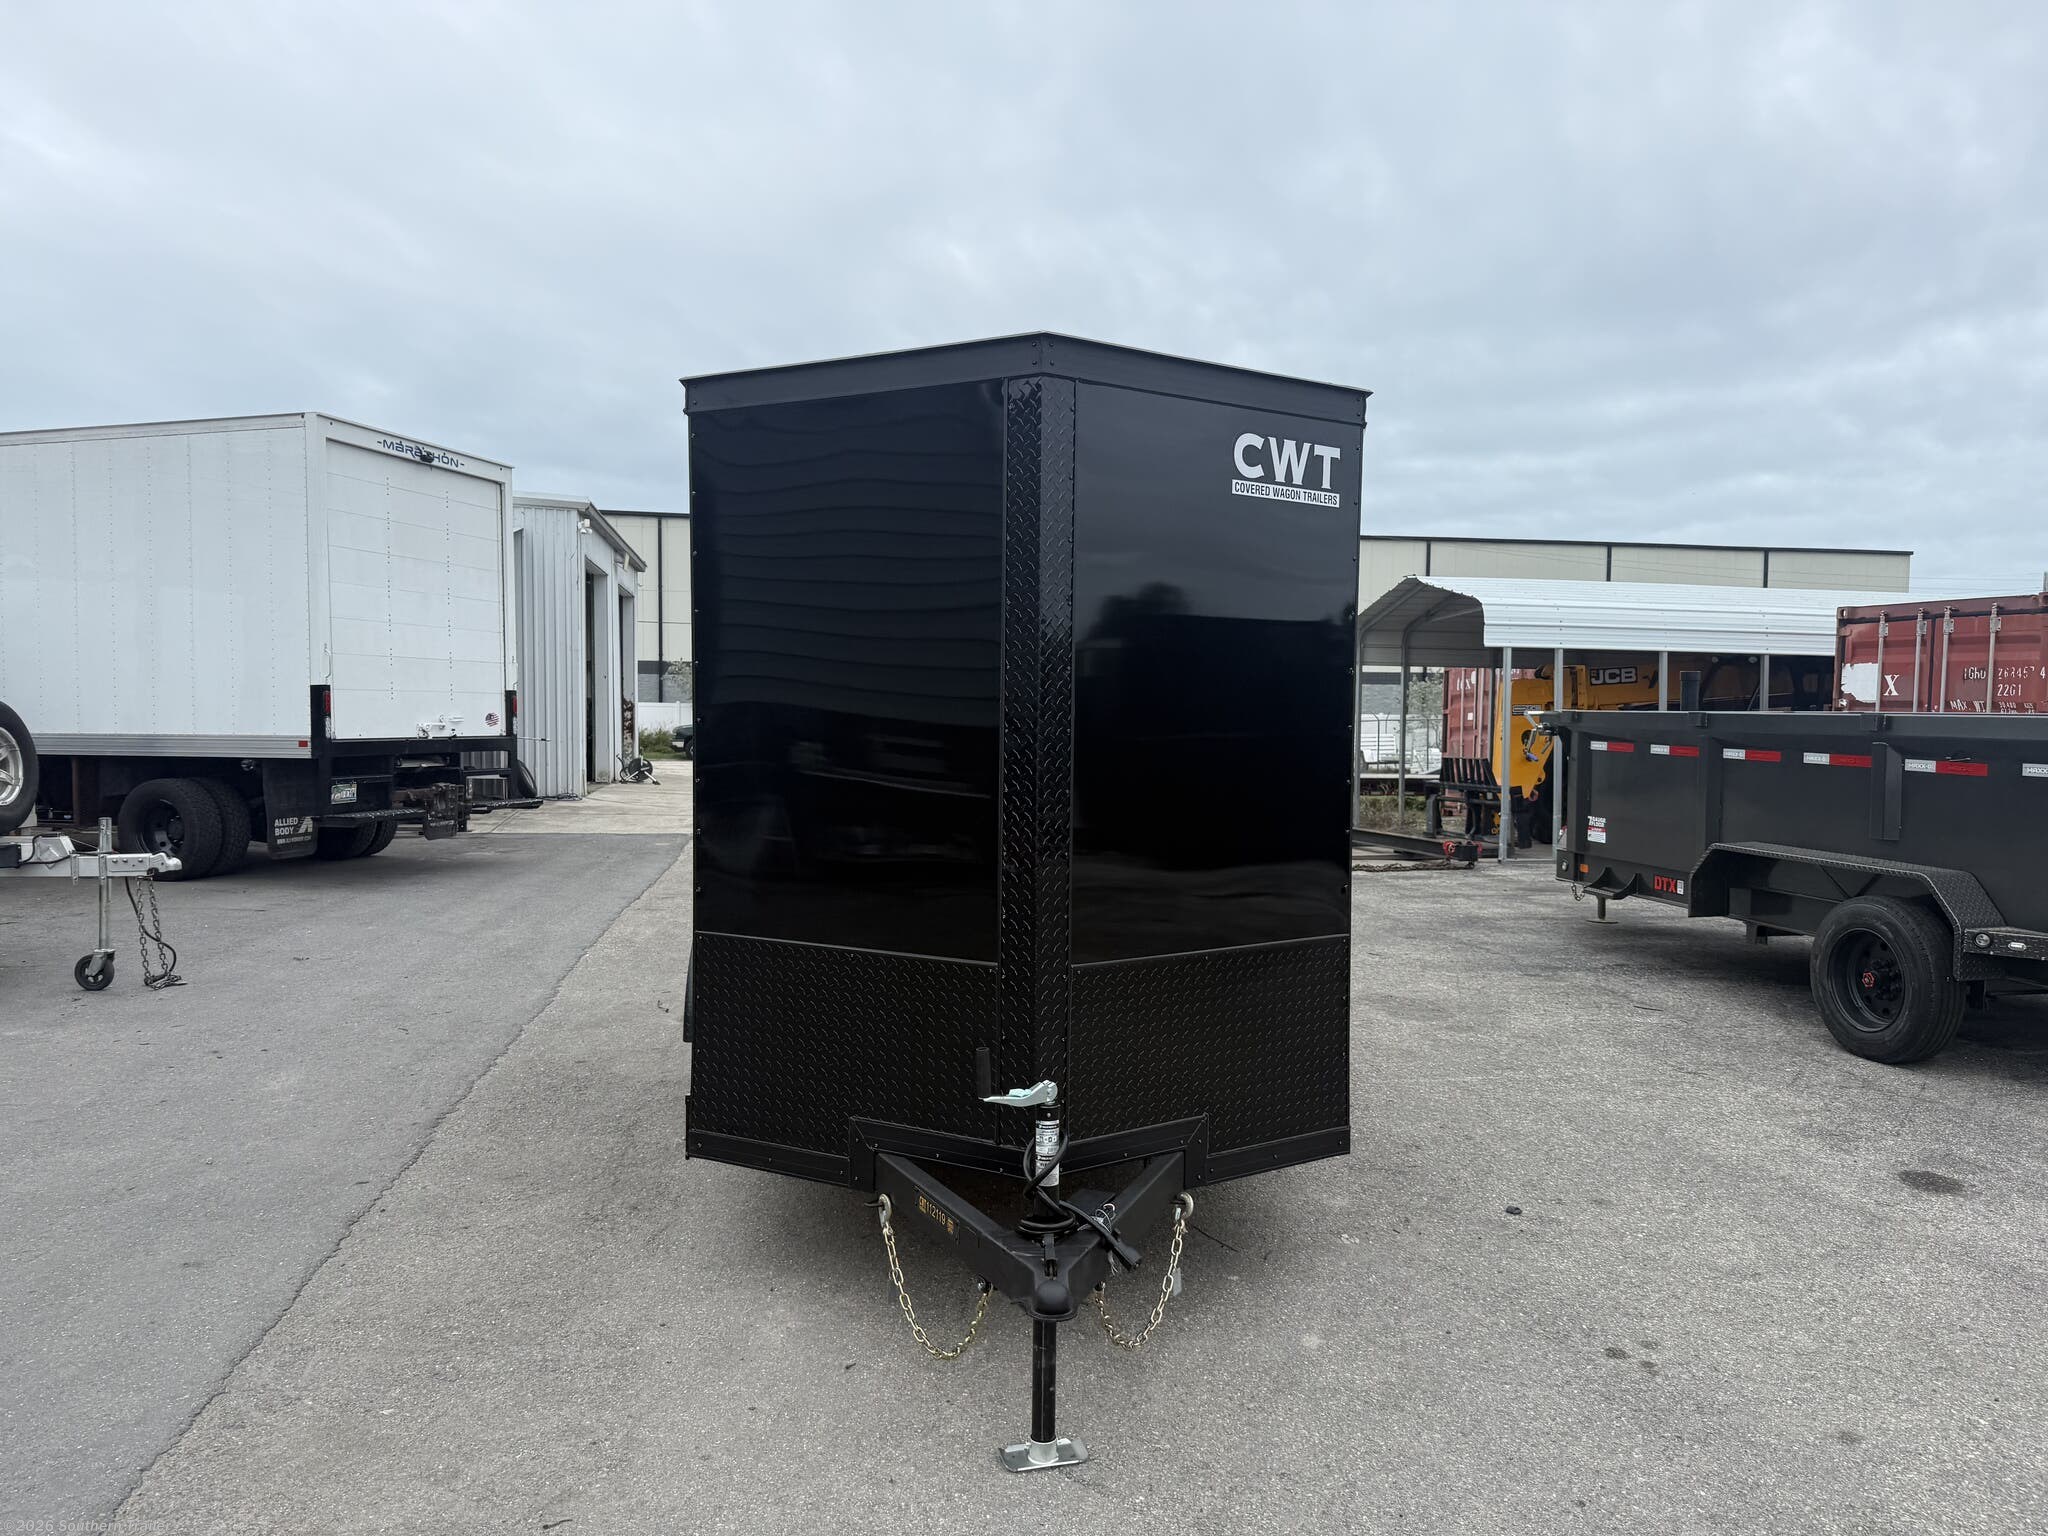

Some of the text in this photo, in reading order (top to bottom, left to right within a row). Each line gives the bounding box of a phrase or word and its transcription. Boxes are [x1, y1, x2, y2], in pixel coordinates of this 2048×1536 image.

[1234, 433, 1340, 489] CWT
[1234, 482, 1338, 506] COVERED WAGON TRAILERS
[1591, 668, 1636, 685] JCB
[2040, 666, 2046, 679] 4
[1997, 683, 2022, 697] 22G1
[274, 817, 298, 827] ALLIED
[274, 827, 295, 836] BODY
[1654, 875, 1677, 893] DTX
